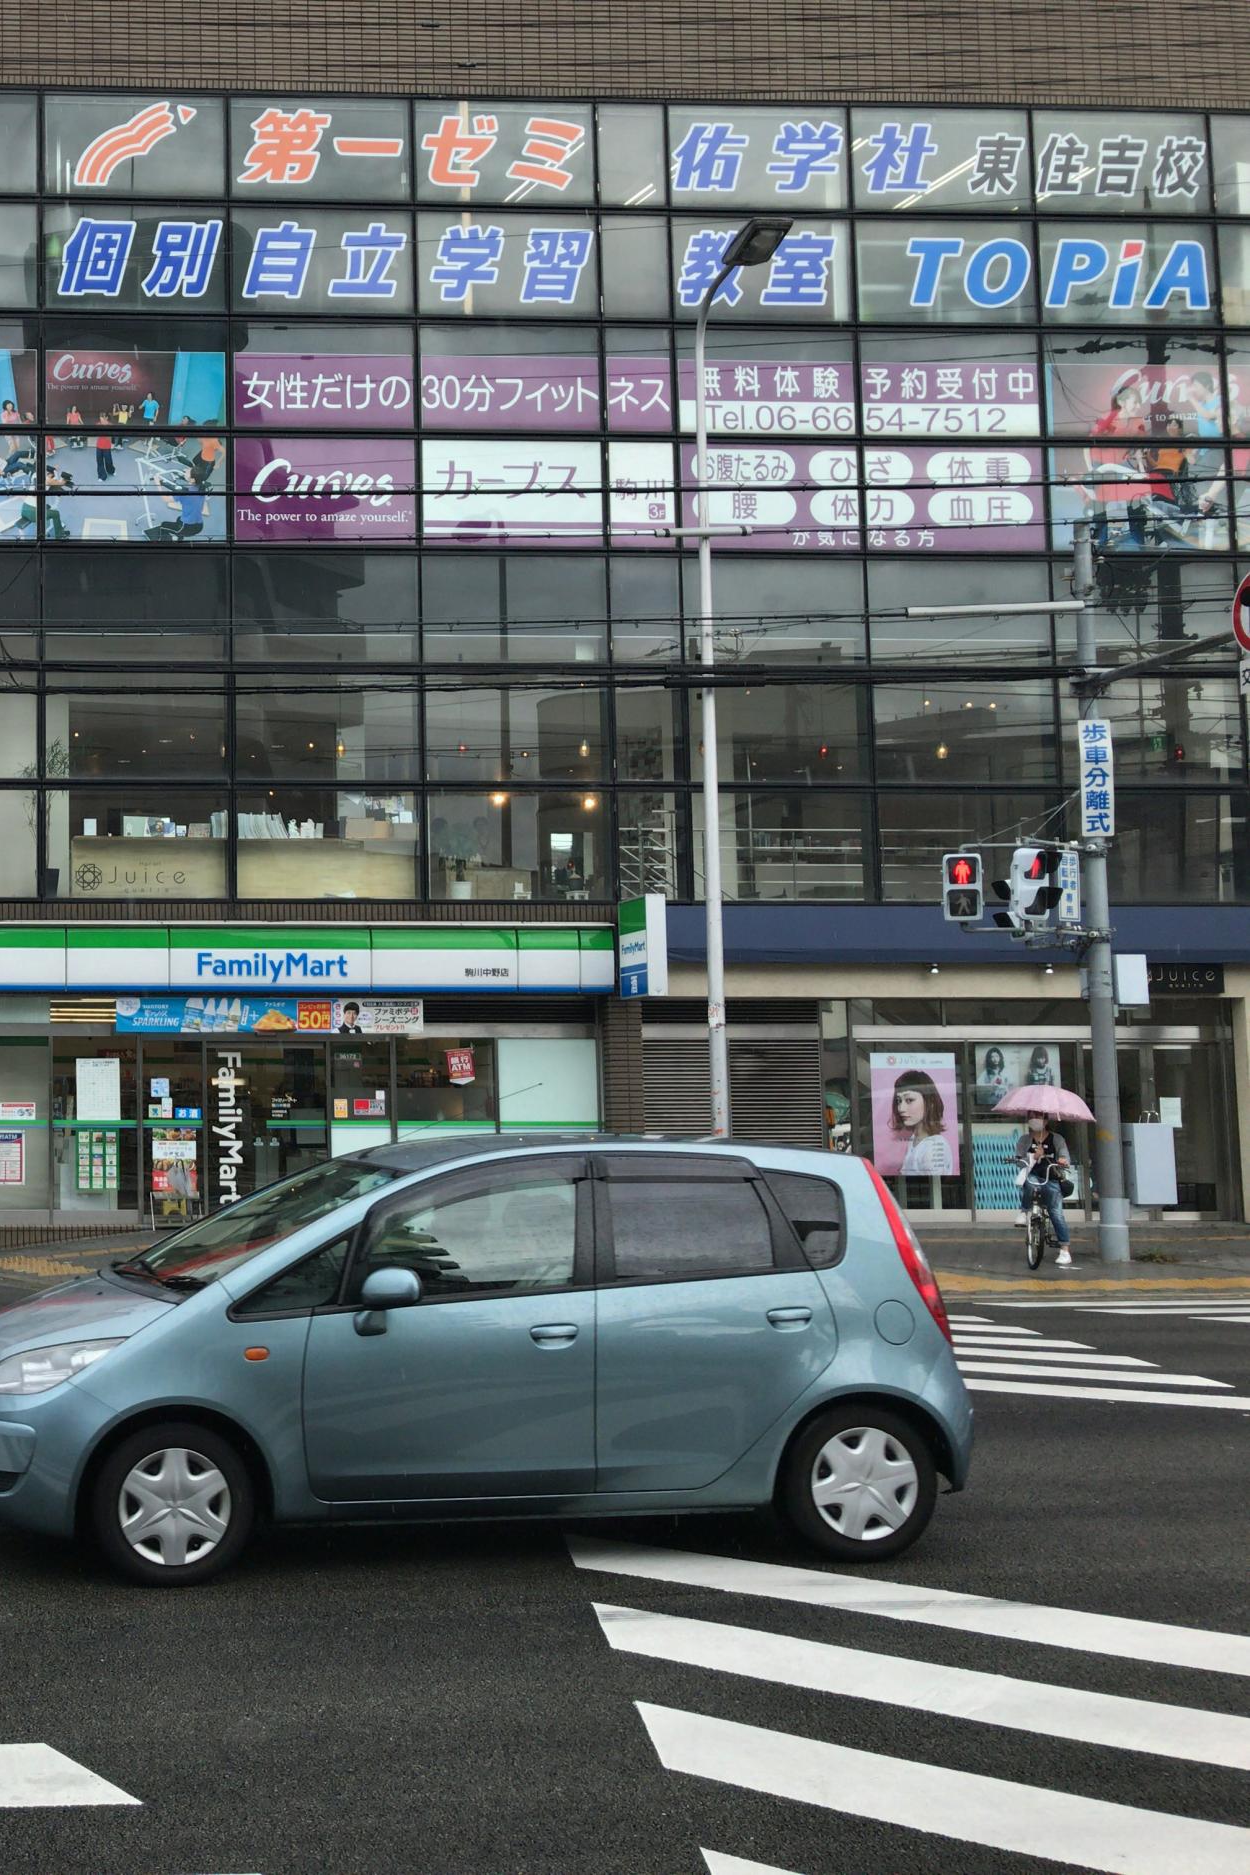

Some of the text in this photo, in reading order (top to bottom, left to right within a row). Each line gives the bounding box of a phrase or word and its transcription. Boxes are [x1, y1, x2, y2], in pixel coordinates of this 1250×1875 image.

[237, 108, 585, 190] 第一ゼミ
[673, 121, 938, 194] 佑学社
[967, 132, 1206, 198] 東住吉校
[52, 354, 132, 384] Curves
[60, 384, 81, 392] power
[250, 457, 394, 506] Curves
[434, 459, 588, 499] カーブス
[829, 456, 892, 484] ひざ
[947, 456, 1011, 484] 体重
[237, 508, 409, 525] The power to amaze yourself.
[649, 504, 666, 520] 3F
[732, 493, 758, 520] 腰
[831, 494, 894, 521] 体力
[949, 496, 1013, 523] 血圧
[793, 529, 935, 548] が気になる方
[1083, 723, 1111, 833] 歩車分離式
[108, 866, 186, 885] Juice
[621, 940, 646, 956] FamilyMart
[197, 952, 348, 983] FamilyMart
[464, 967, 509, 978] 駒川中野店
[132, 1017, 180, 1027] SPARKLING
[300, 1011, 331, 1030] 50円
[374, 1016, 420, 1024] シーズニング
[451, 1063, 471, 1072] ATM
[212, 1052, 244, 1205] FamilyMart
